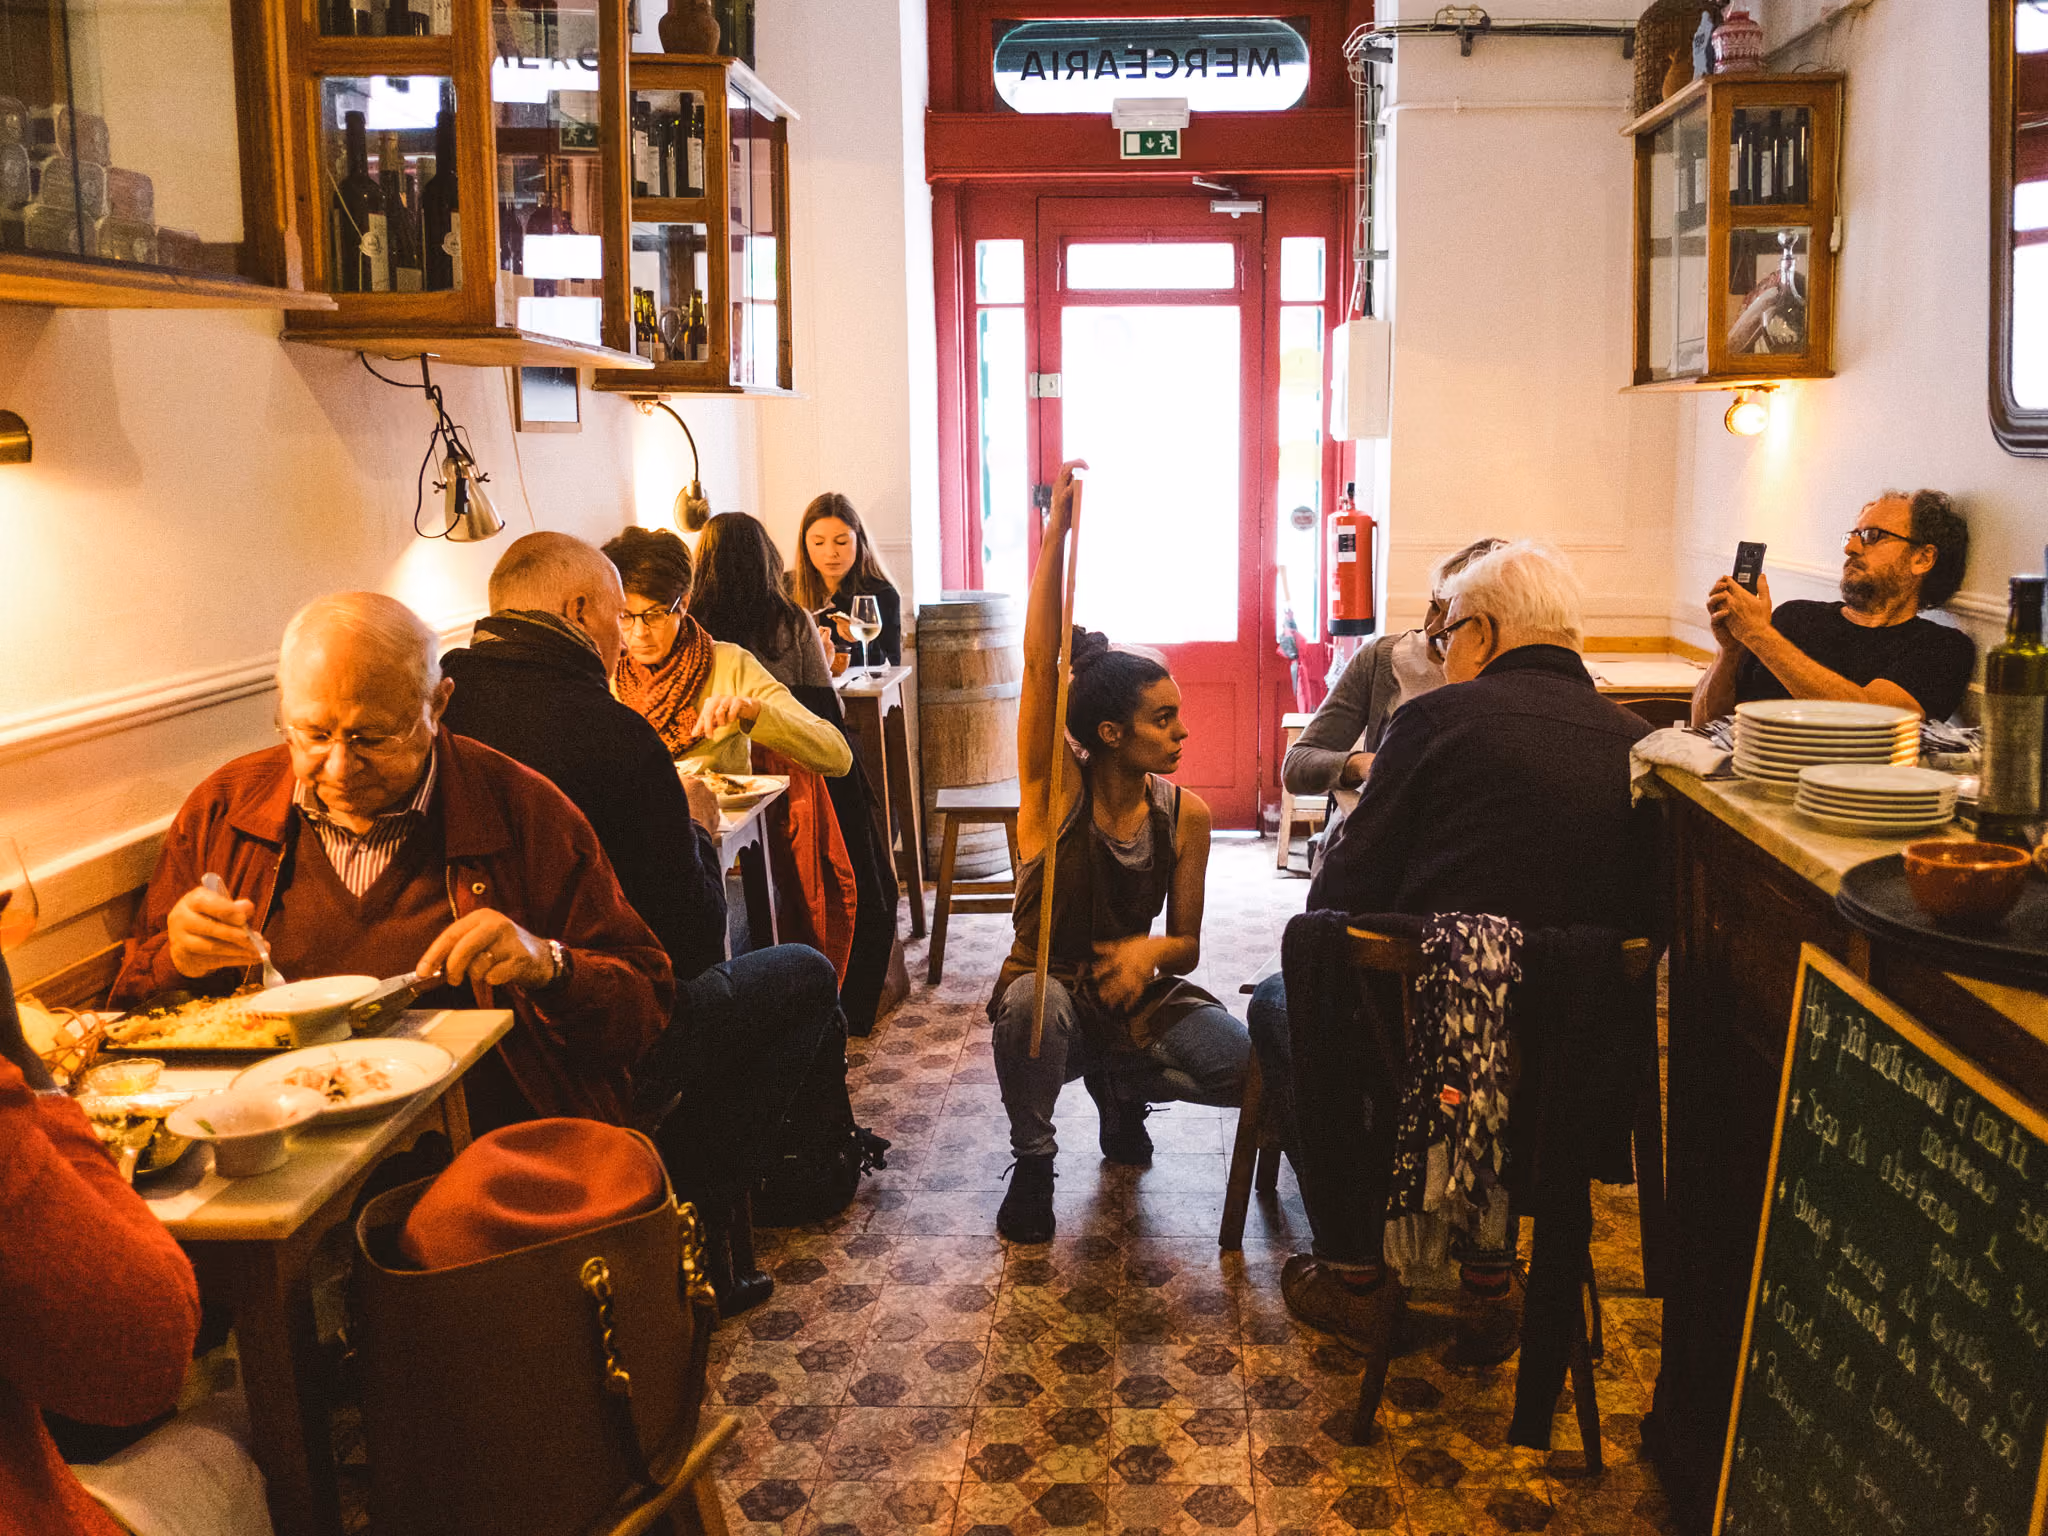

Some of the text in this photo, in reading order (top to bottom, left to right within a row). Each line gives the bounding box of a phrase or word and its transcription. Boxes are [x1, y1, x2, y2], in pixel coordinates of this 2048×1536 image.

[1804, 1088, 1839, 1163] Sopa
[1848, 1125, 1867, 1165] de
[1899, 1284, 1917, 1323] de
[1896, 1335, 1917, 1376] da
